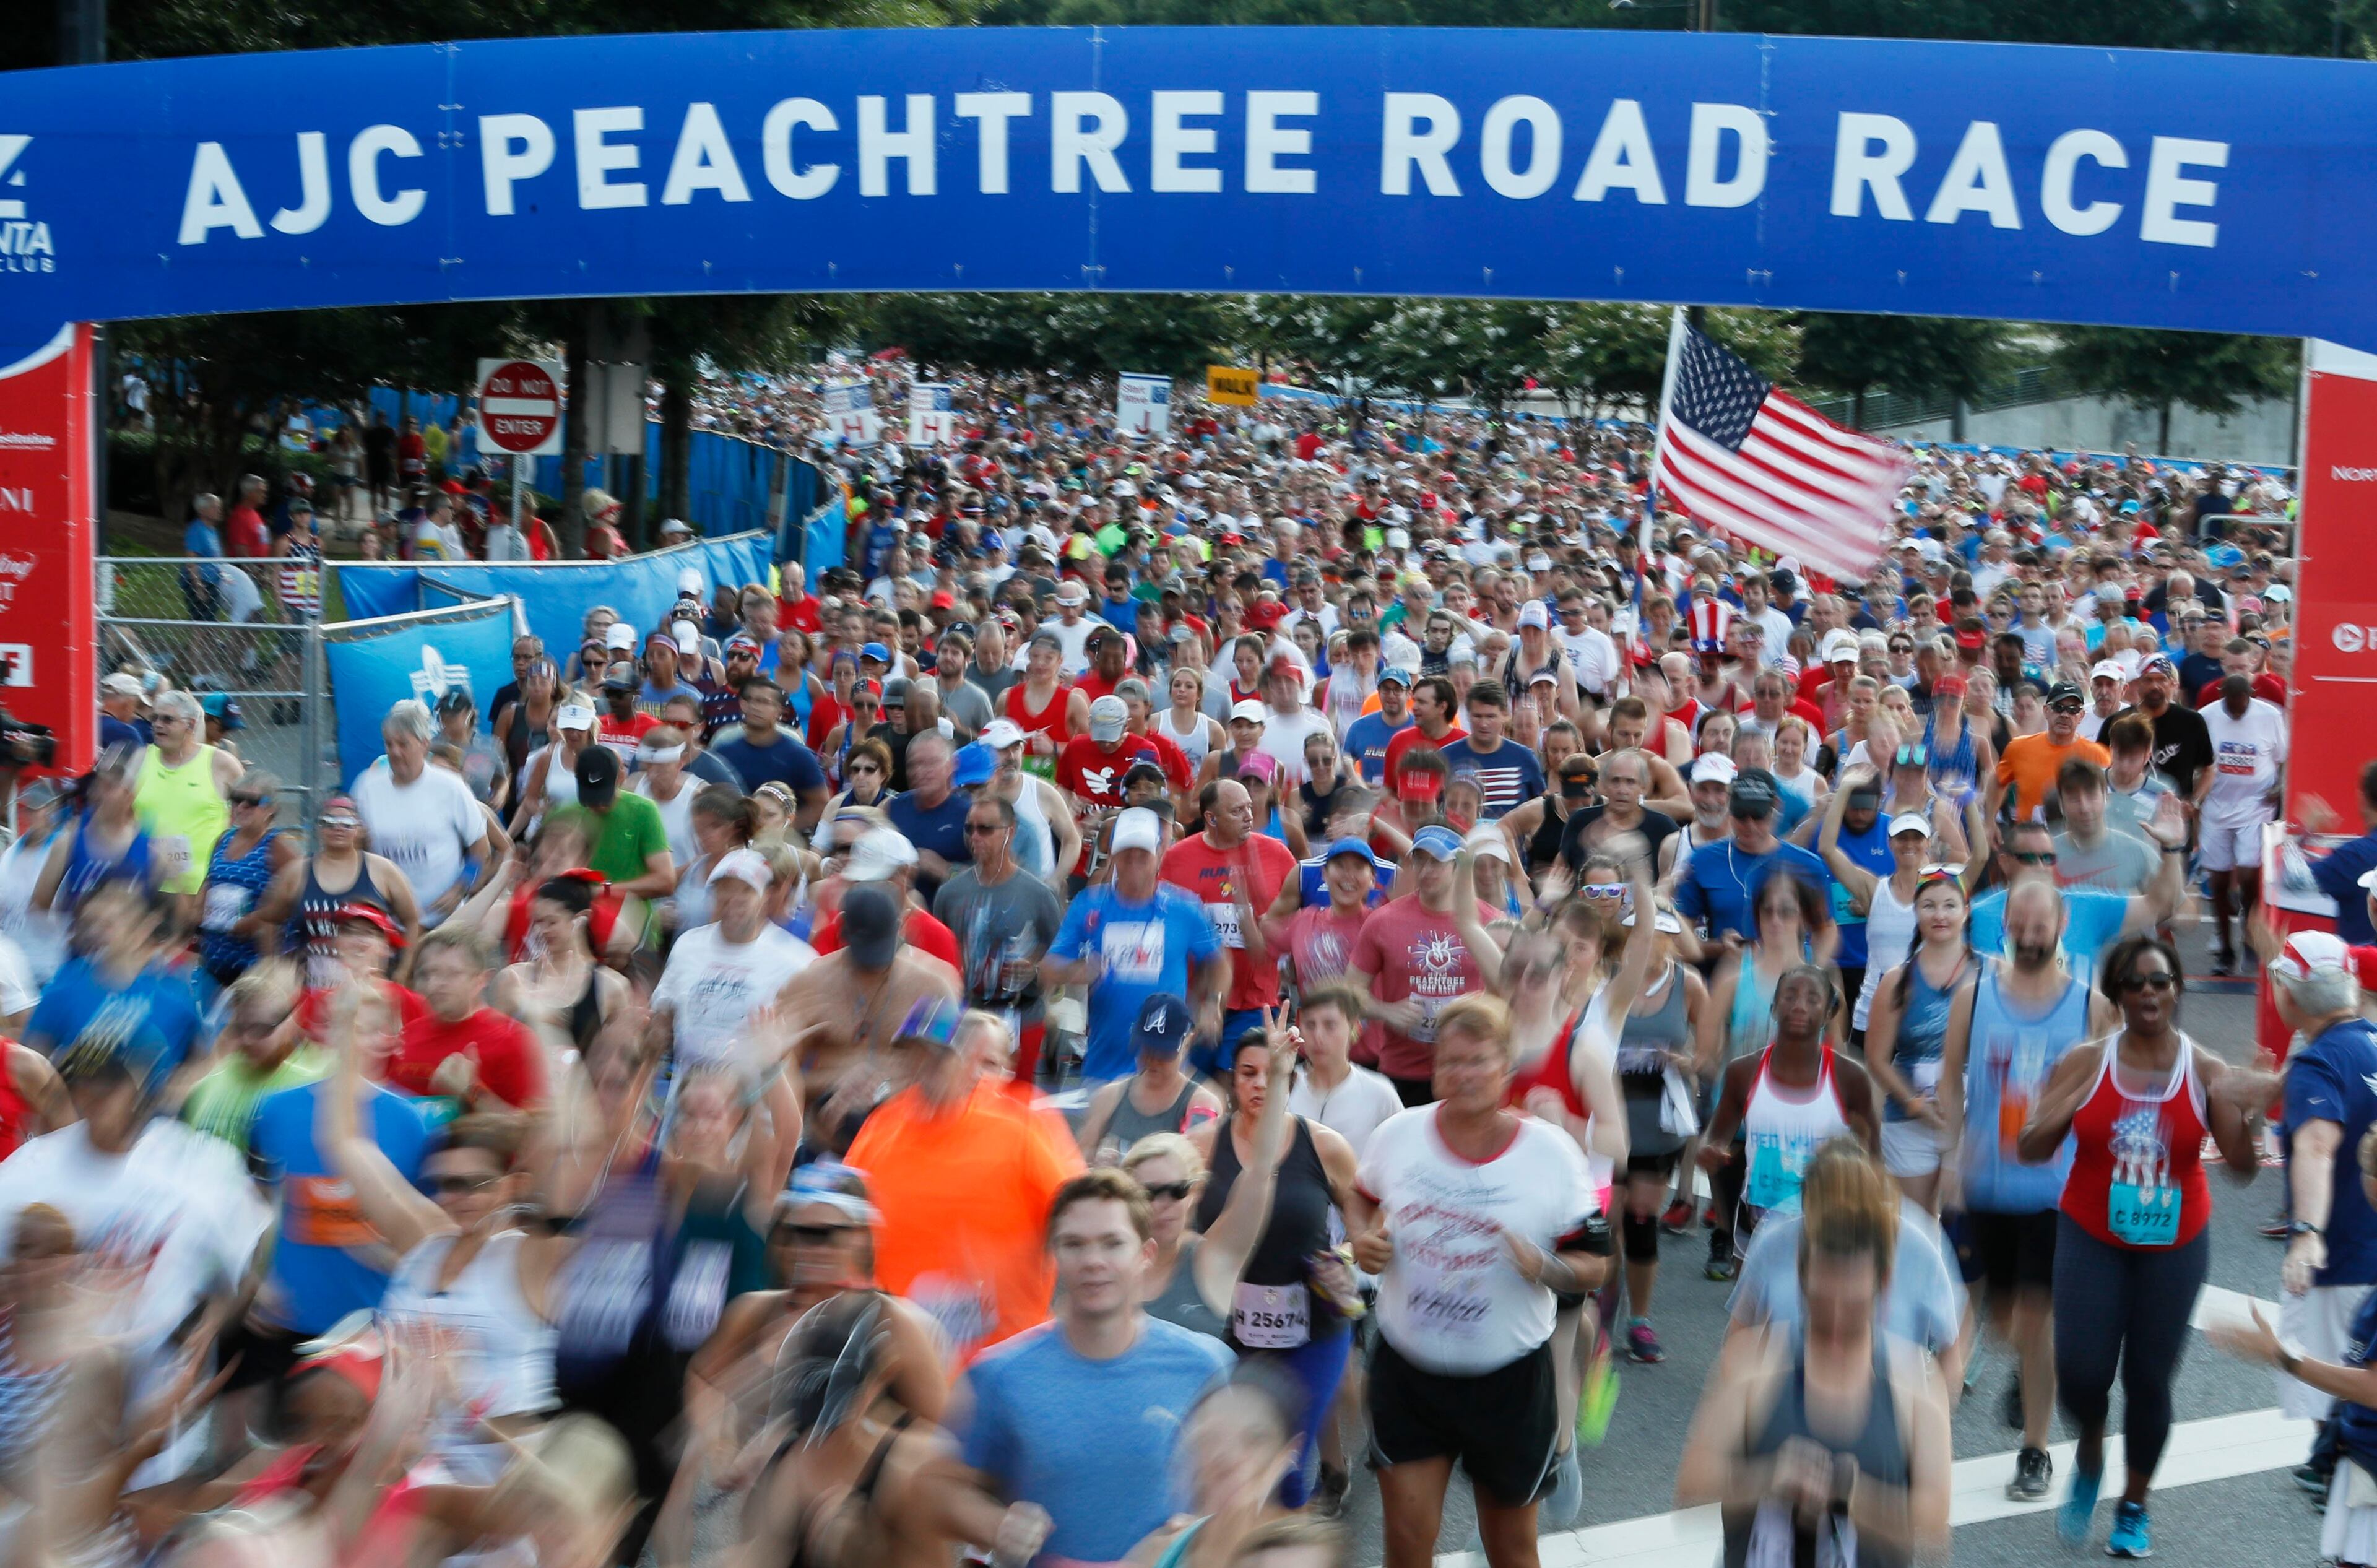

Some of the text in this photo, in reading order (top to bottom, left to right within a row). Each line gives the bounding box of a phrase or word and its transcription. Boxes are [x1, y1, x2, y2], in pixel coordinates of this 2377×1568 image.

[179, 90, 2230, 248] AJC PEACHTREE ROAD RACE
[490, 377, 550, 396] DO NOT
[495, 418, 542, 436] ENTER
[842, 415, 865, 440] H
[920, 415, 942, 441] H
[1409, 975, 1466, 987] PEACHTREE
[2115, 1210, 2171, 1228] C 8972
[1235, 1309, 1245, 1325] H
